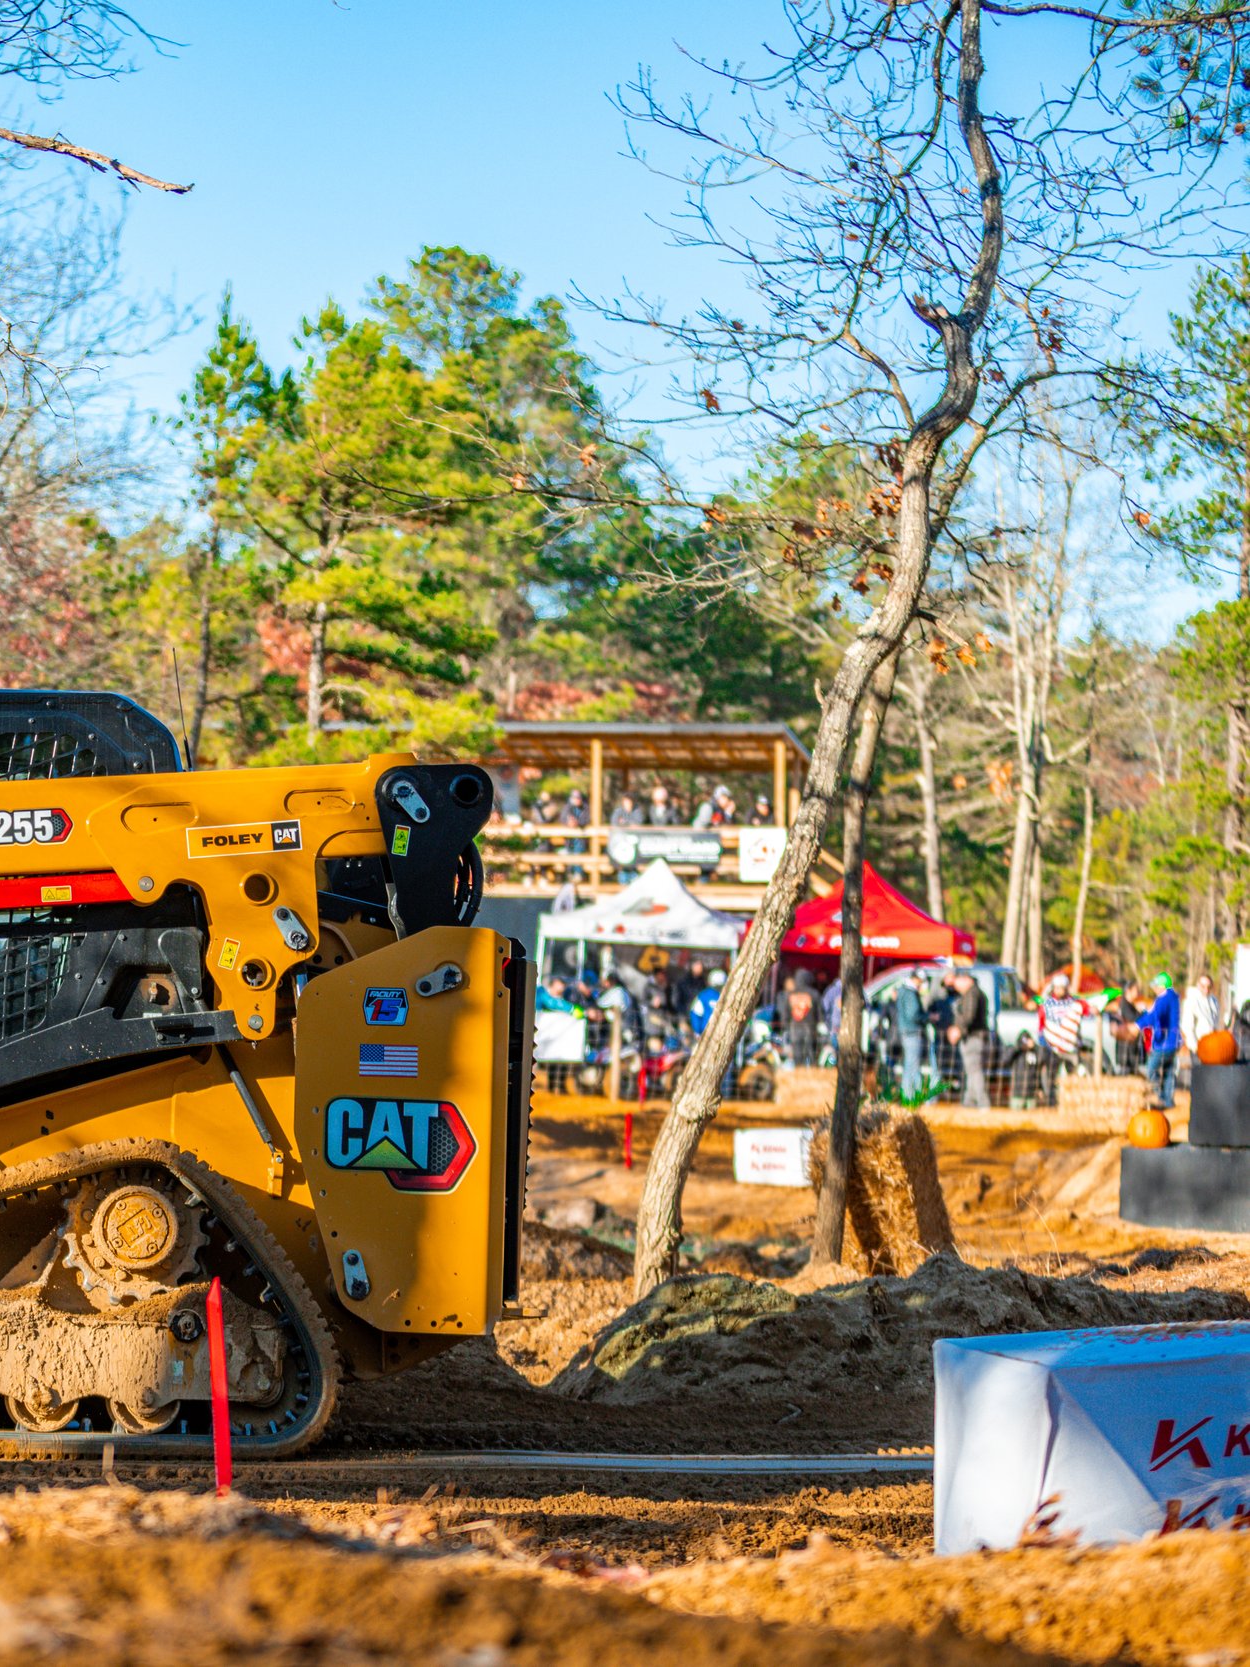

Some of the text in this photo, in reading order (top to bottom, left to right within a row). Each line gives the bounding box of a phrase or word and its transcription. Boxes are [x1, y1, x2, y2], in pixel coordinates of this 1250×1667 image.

[201, 832, 264, 848] FOLEY
[273, 827, 299, 844] CAT
[369, 998, 402, 1022] 15
[327, 1099, 438, 1170] CAT
